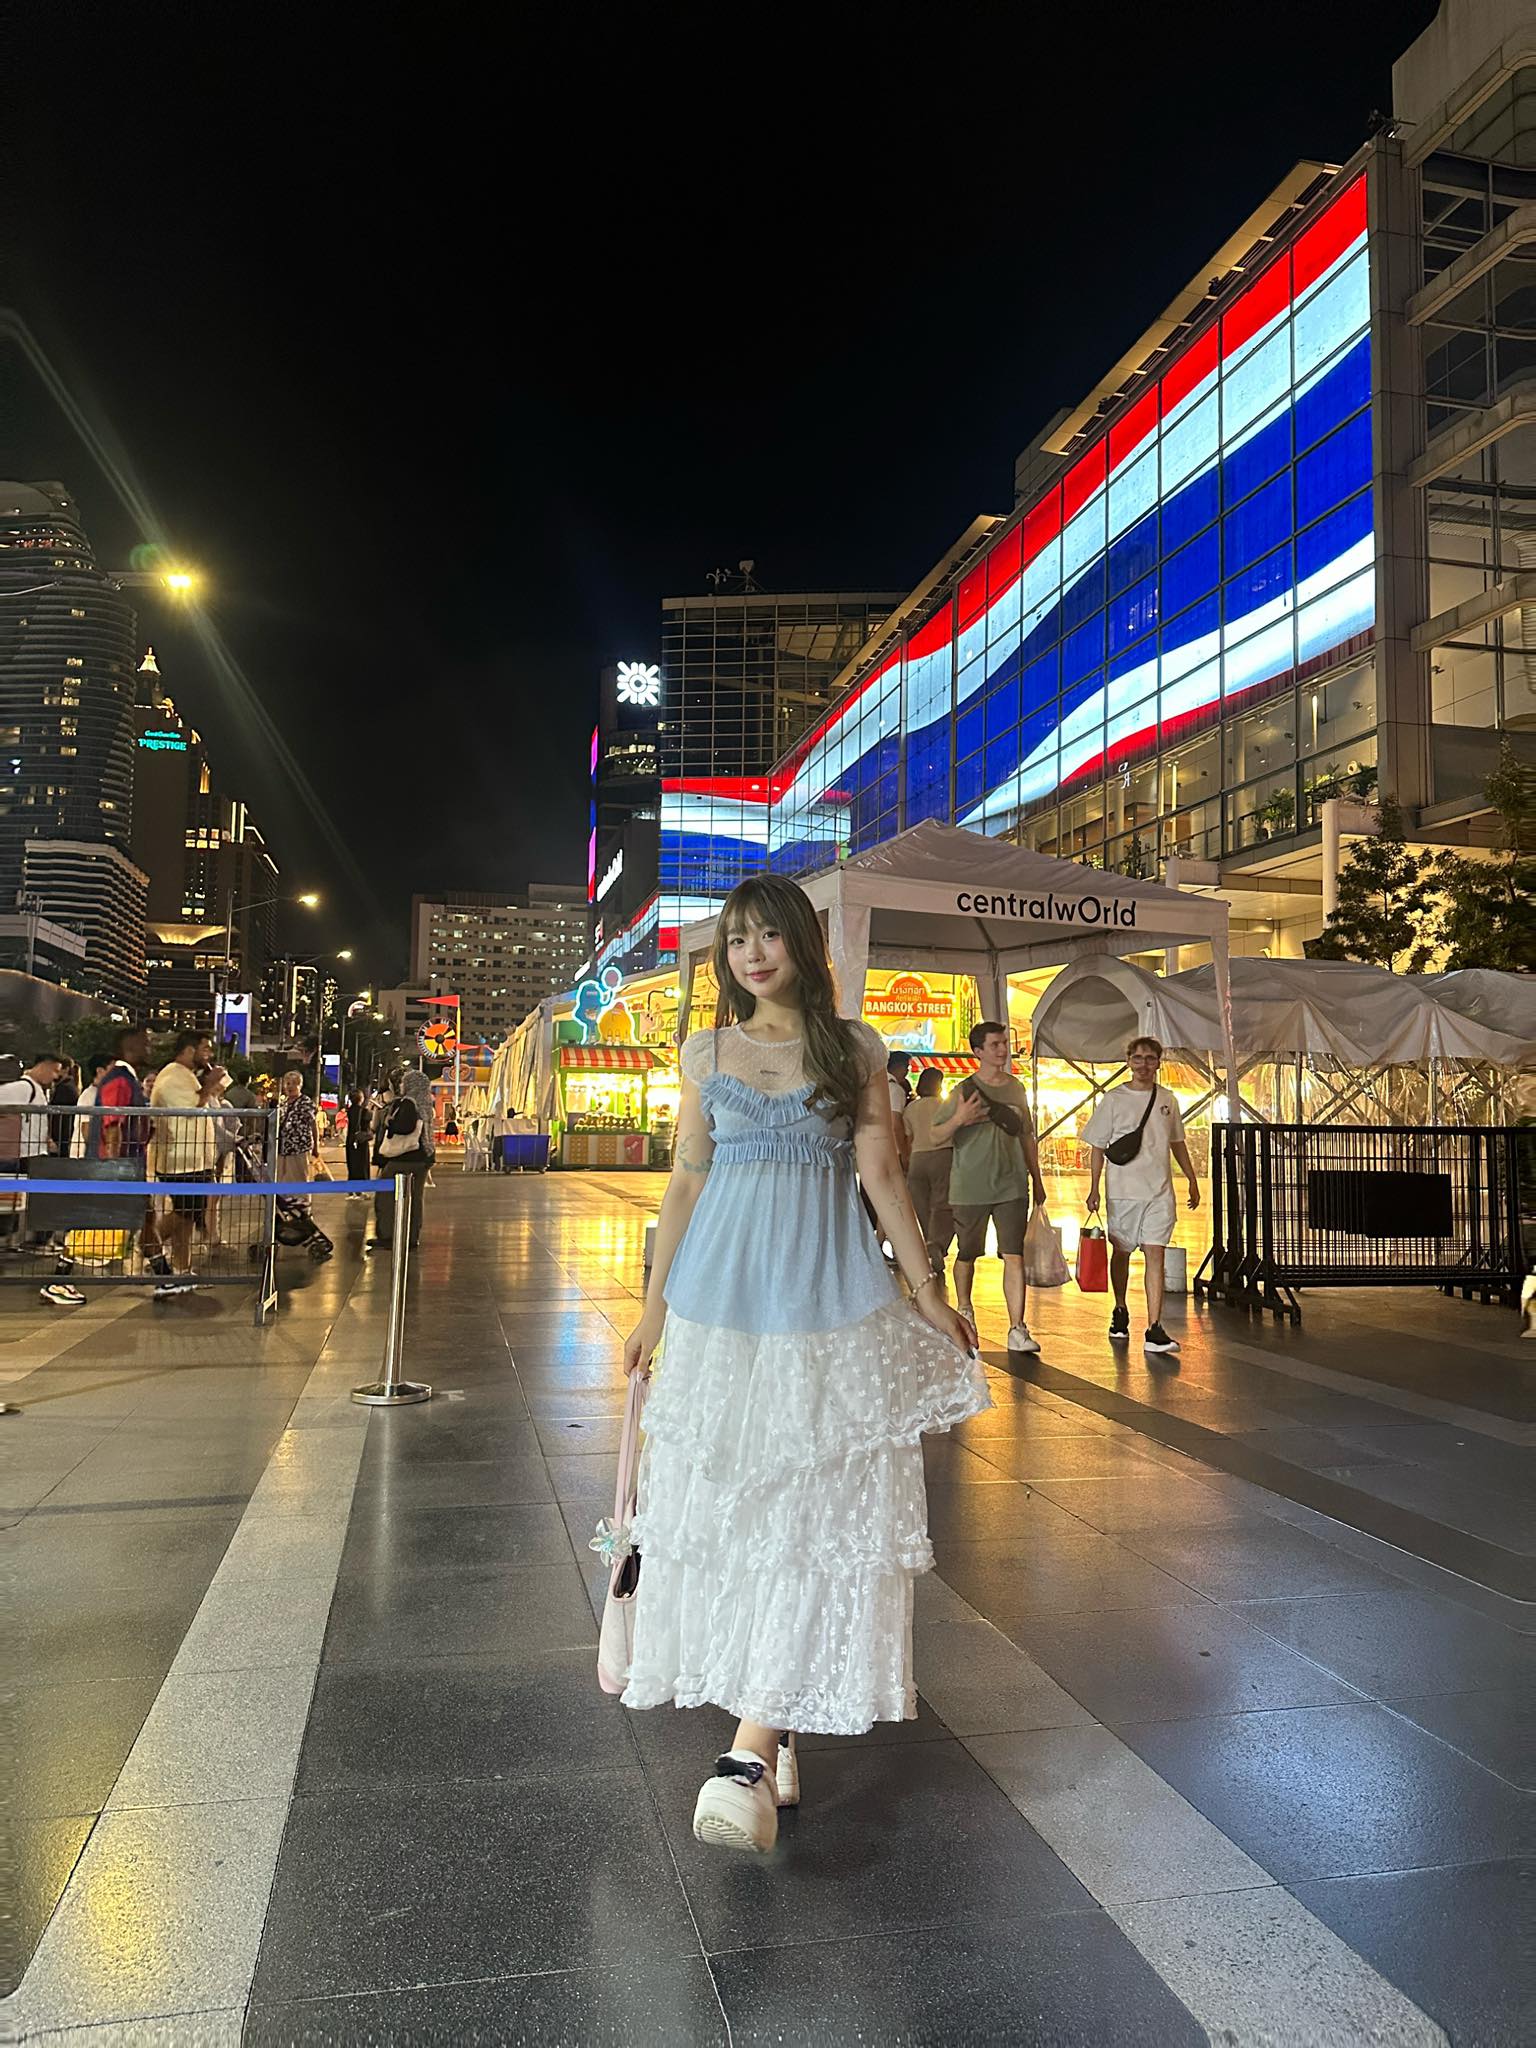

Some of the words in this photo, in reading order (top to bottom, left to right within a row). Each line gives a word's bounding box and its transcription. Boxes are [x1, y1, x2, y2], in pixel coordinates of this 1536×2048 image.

[137, 738, 187, 751] PRESTIGE
[956, 892, 1137, 927] centralwOrld
[865, 1001, 914, 1013] BANGKOK
[916, 1002, 952, 1015] STREET
